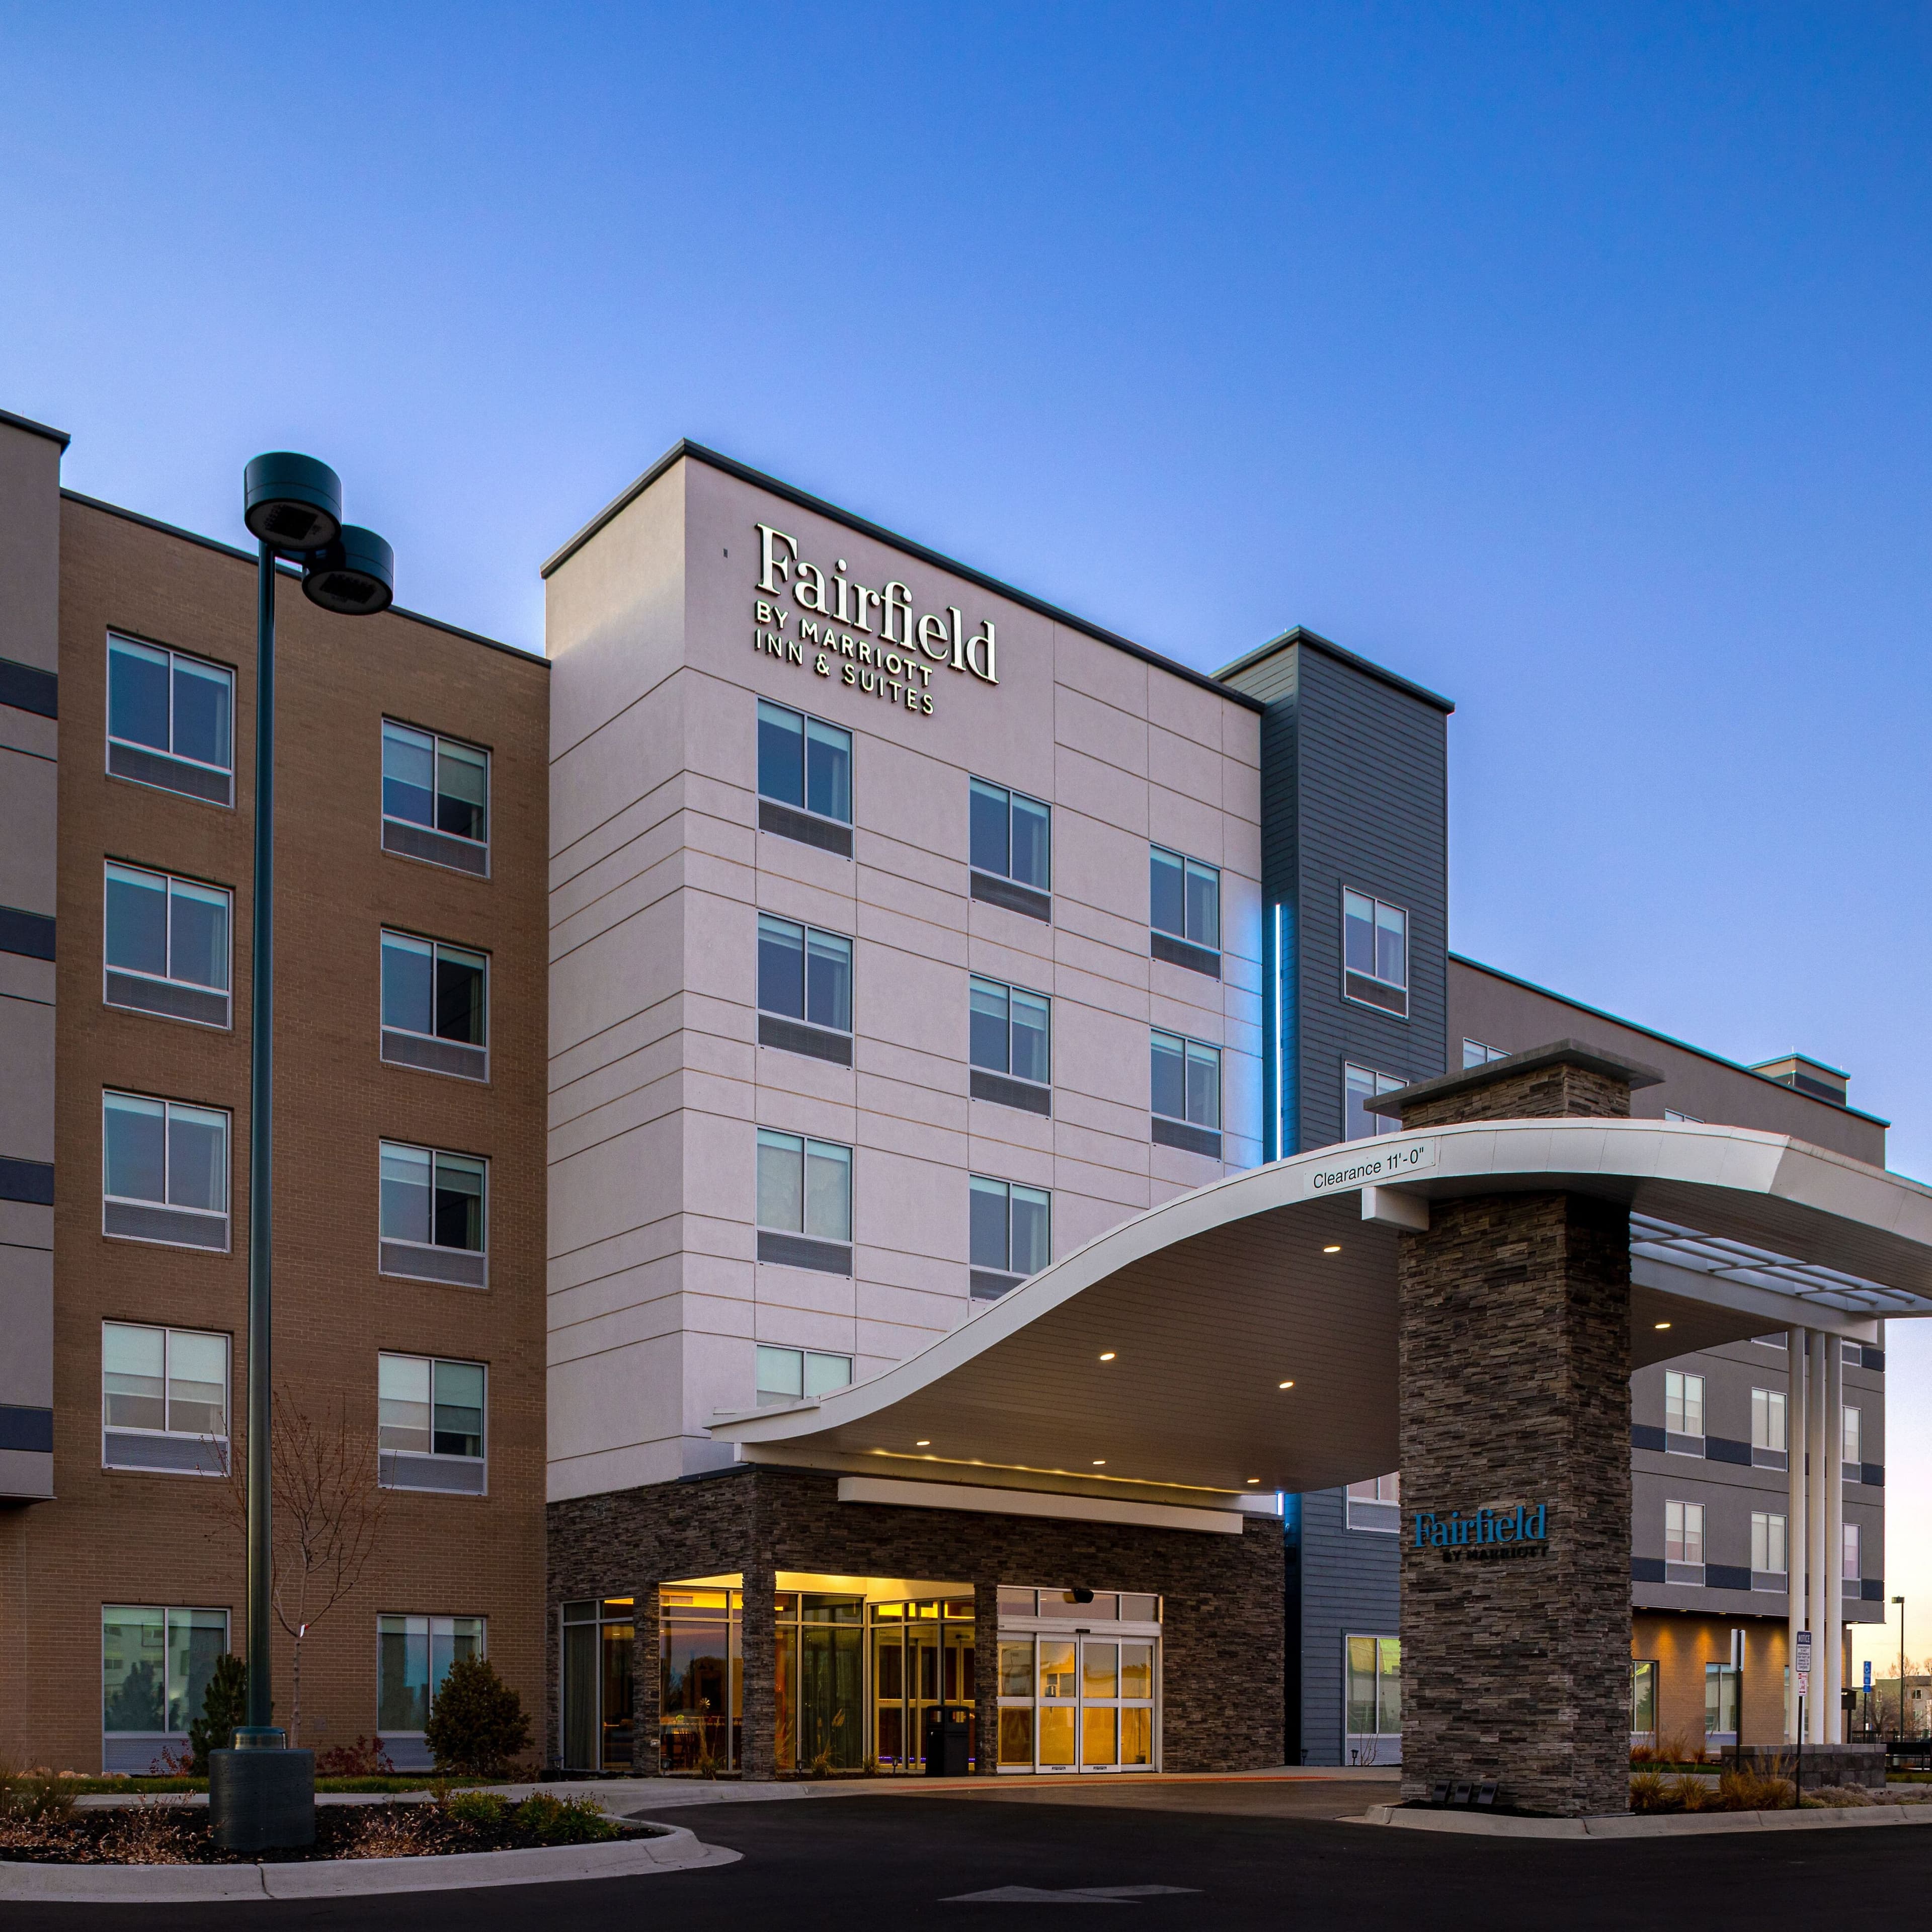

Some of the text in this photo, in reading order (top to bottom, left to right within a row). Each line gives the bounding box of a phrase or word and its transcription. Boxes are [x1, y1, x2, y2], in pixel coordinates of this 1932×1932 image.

[755, 523, 999, 685] Fairfield
[755, 628, 933, 715] INN & SUITES
[756, 600, 933, 687] BY MARRIOTT
[1313, 1162, 1381, 1188] Clearance
[1413, 1504, 1547, 1548] Fairfield
[1442, 1546, 1549, 1562] BY MARRIOTT
